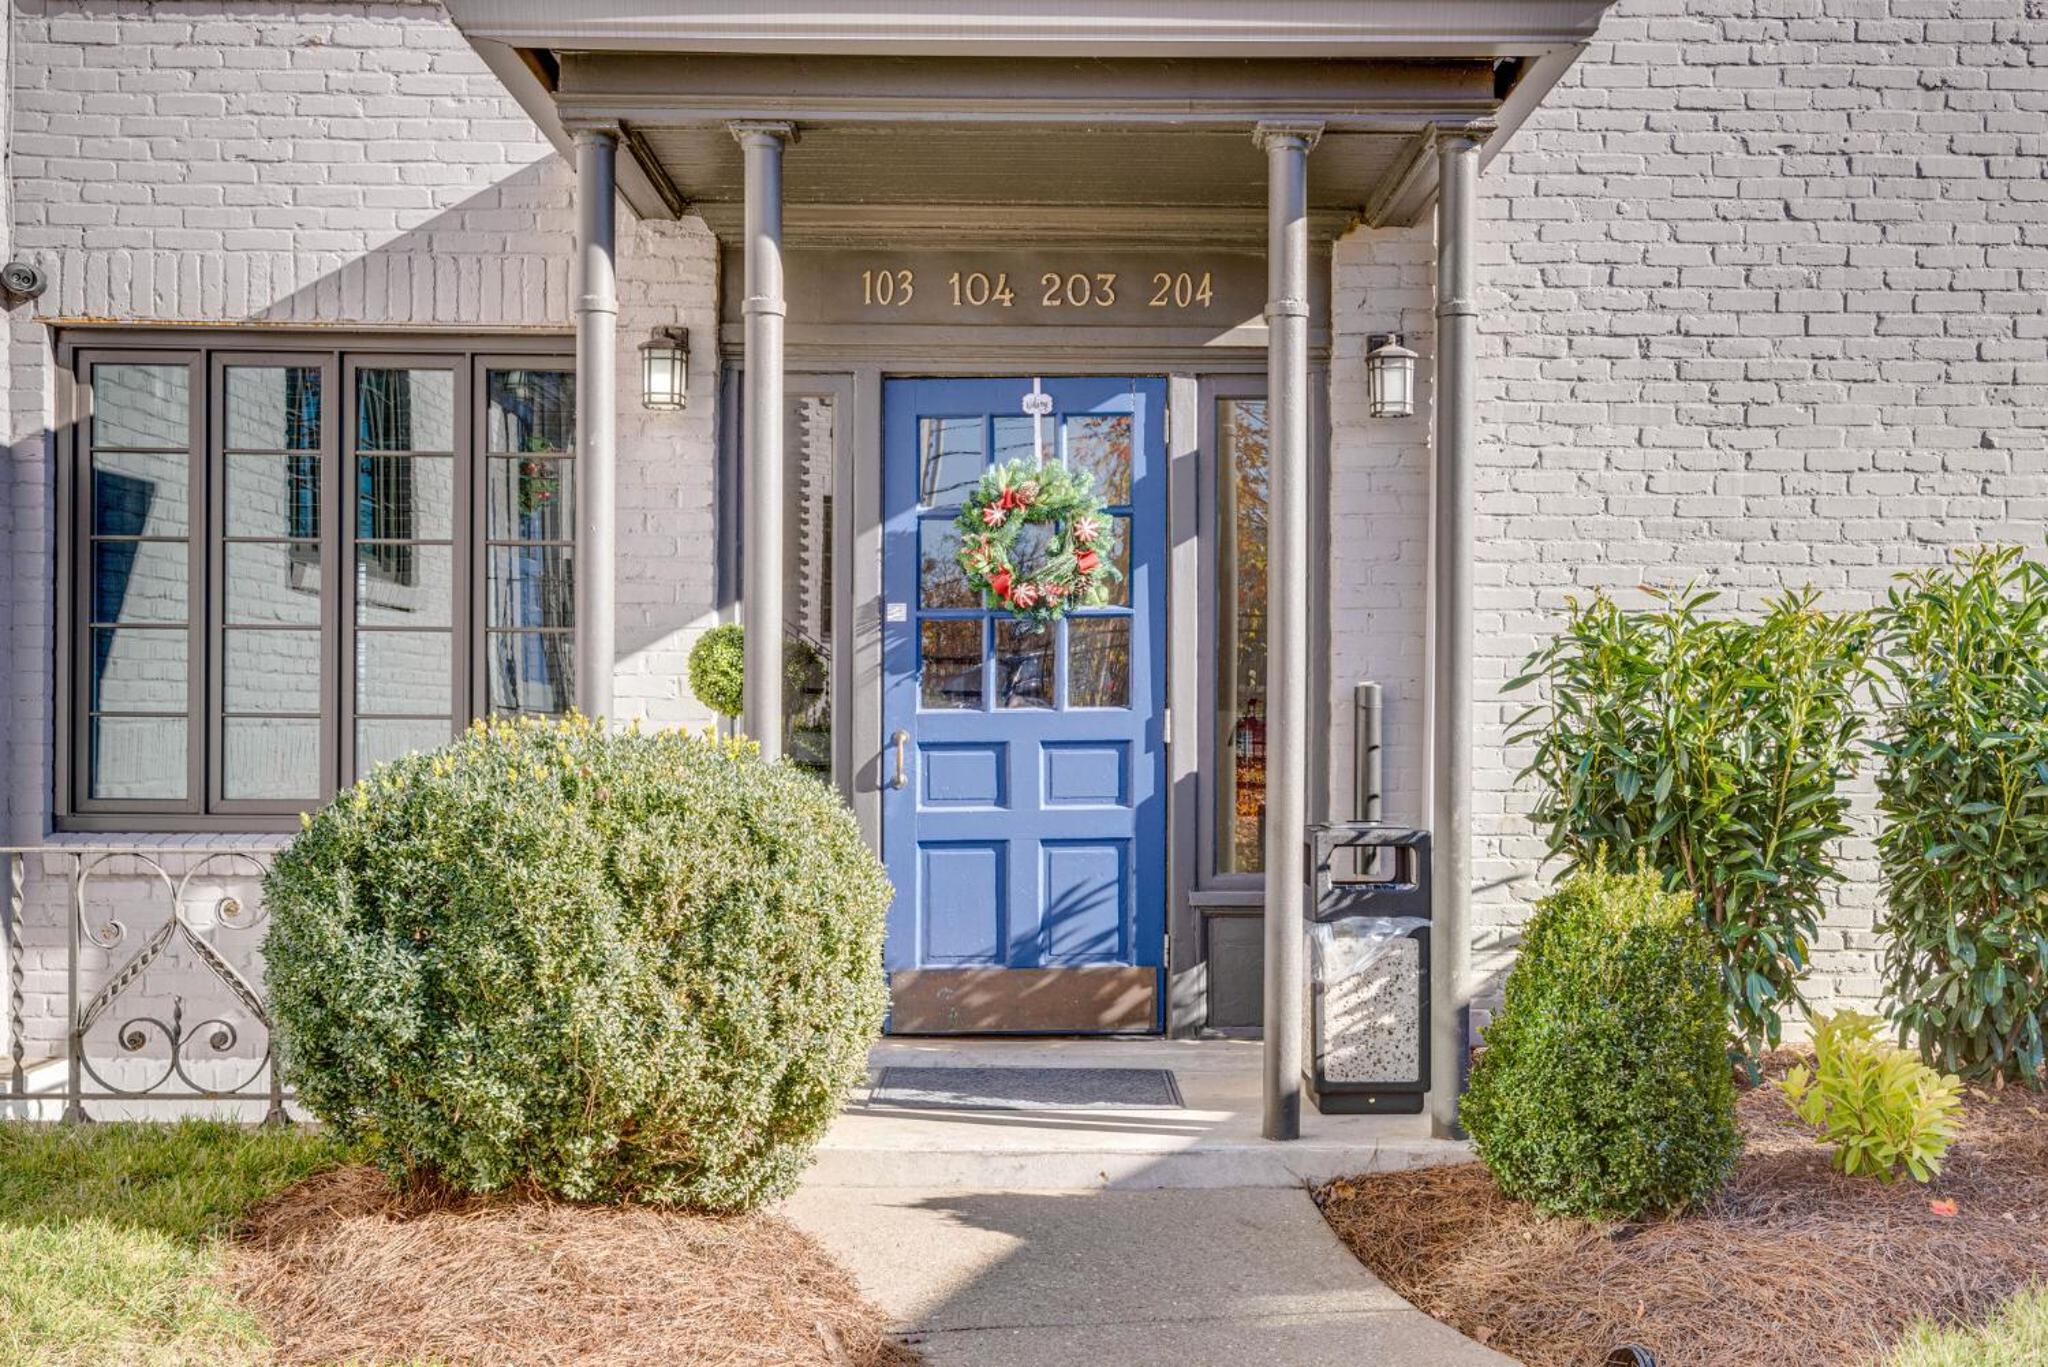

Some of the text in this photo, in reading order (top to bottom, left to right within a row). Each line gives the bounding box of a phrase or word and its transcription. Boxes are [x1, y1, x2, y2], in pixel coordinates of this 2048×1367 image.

[861, 269, 1213, 308] 103 104 203 204
